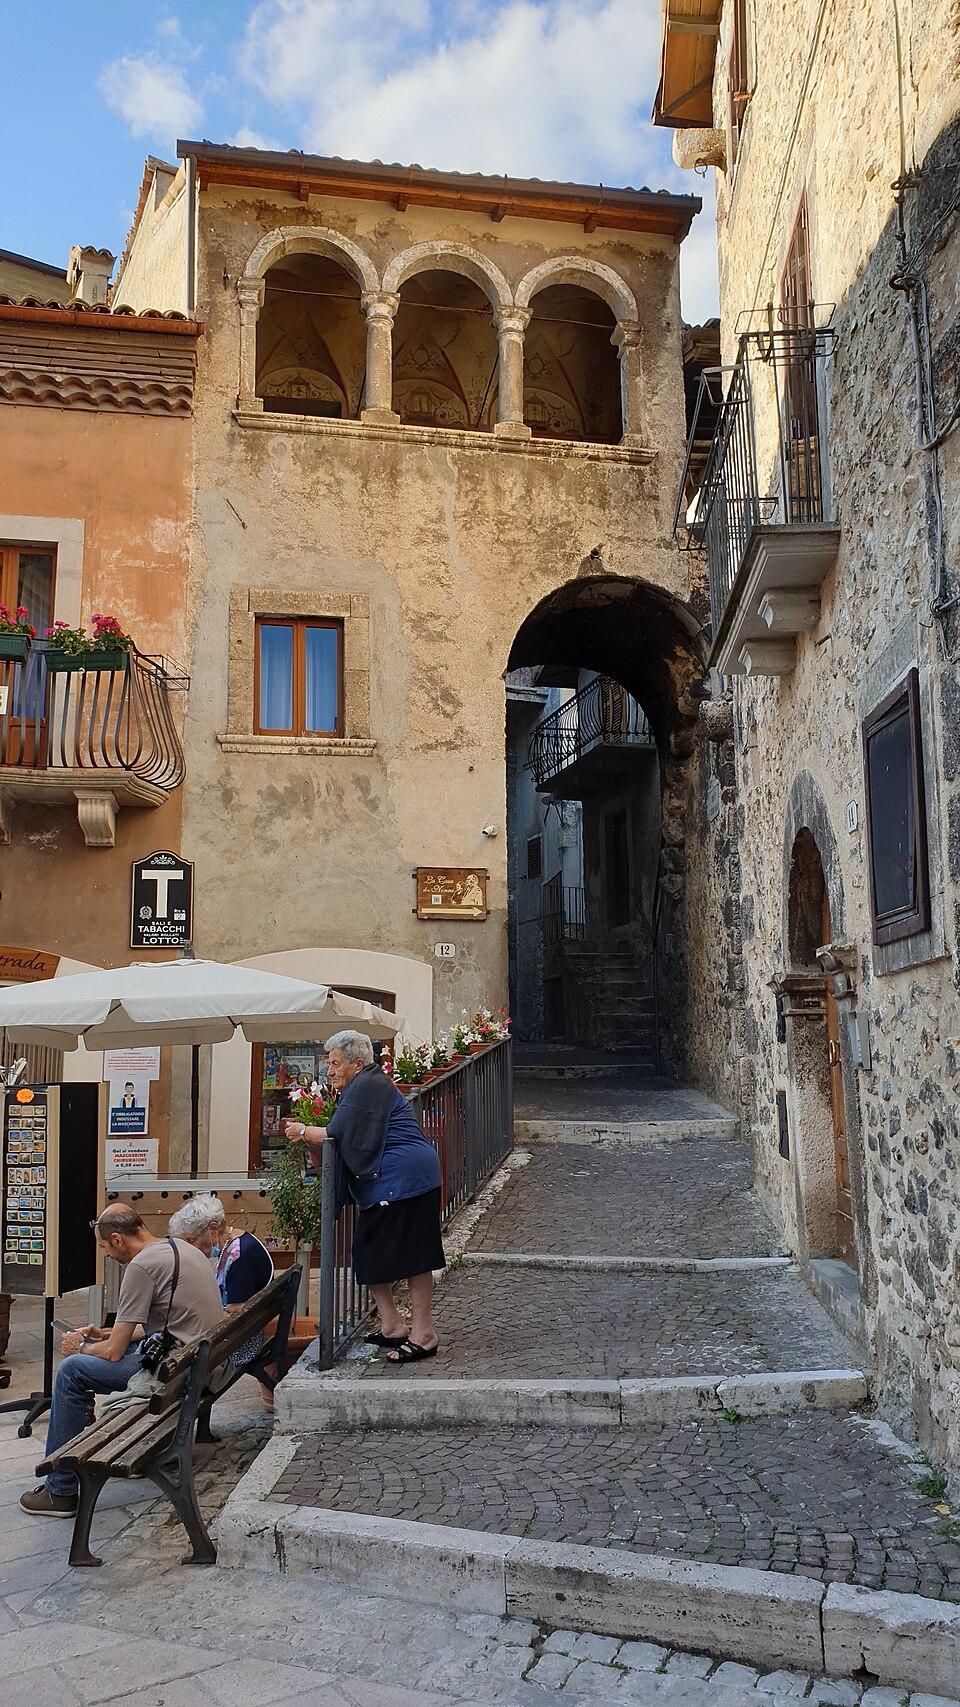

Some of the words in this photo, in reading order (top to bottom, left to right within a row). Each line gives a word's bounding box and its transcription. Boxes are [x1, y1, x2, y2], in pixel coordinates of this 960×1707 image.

[141, 869, 183, 918] T
[137, 925, 185, 933] TABACCHI
[440, 945, 450, 955] 12
